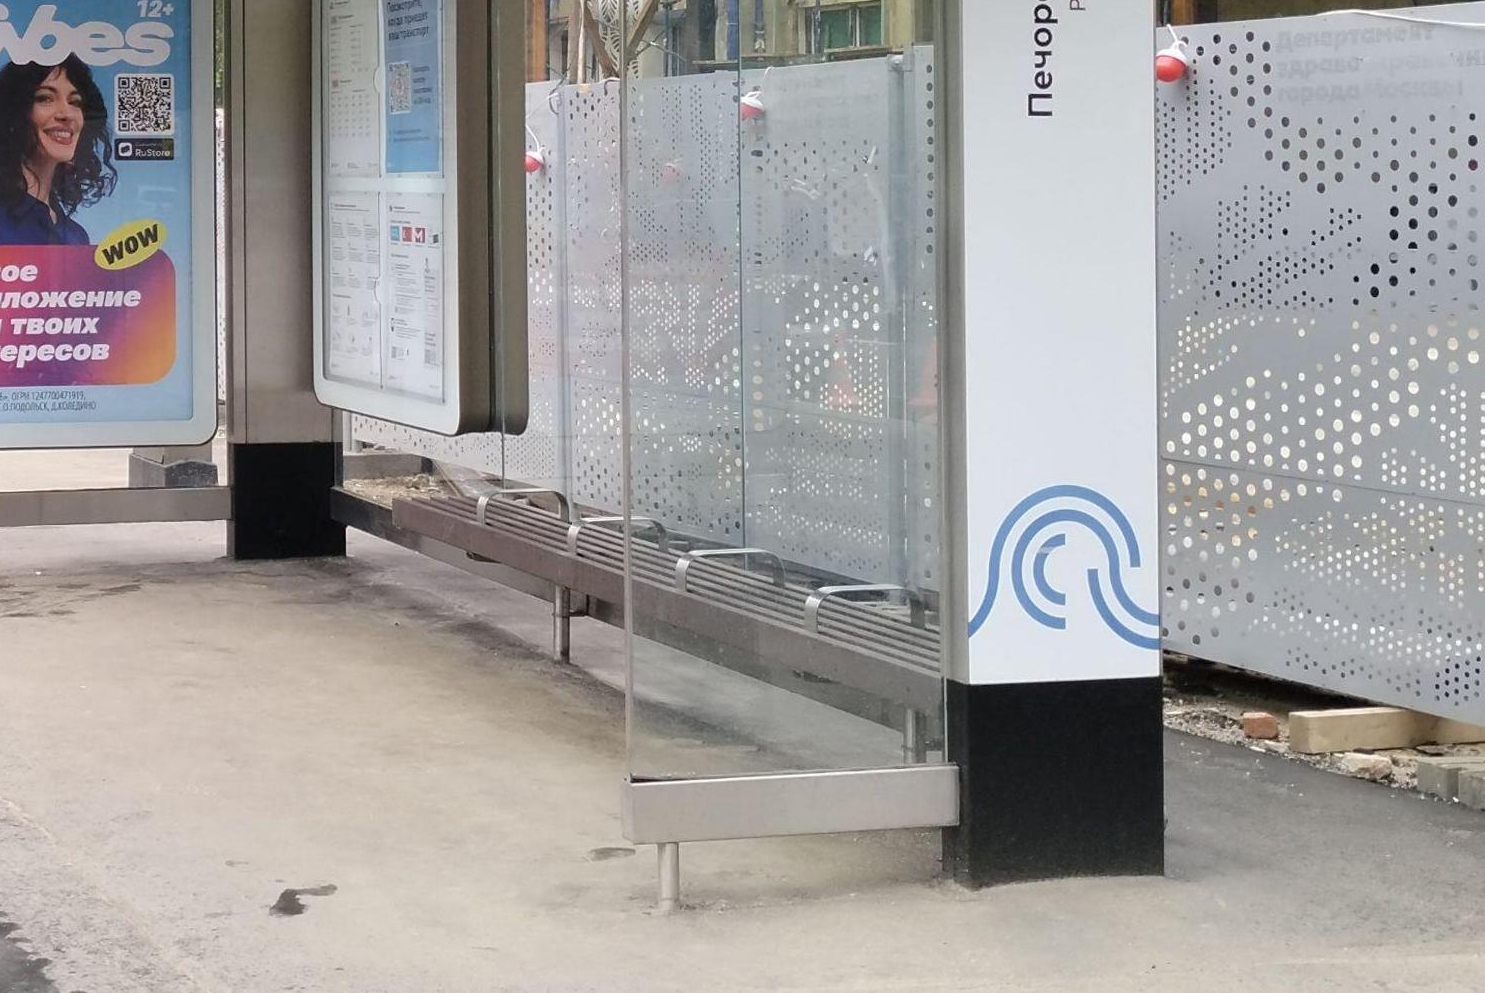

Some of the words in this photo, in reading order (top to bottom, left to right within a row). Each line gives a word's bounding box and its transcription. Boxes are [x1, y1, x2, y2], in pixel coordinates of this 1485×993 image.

[136, 0, 174, 18] 12+
[135, 148, 171, 157] RuStore
[10, 317, 100, 335] твоих
